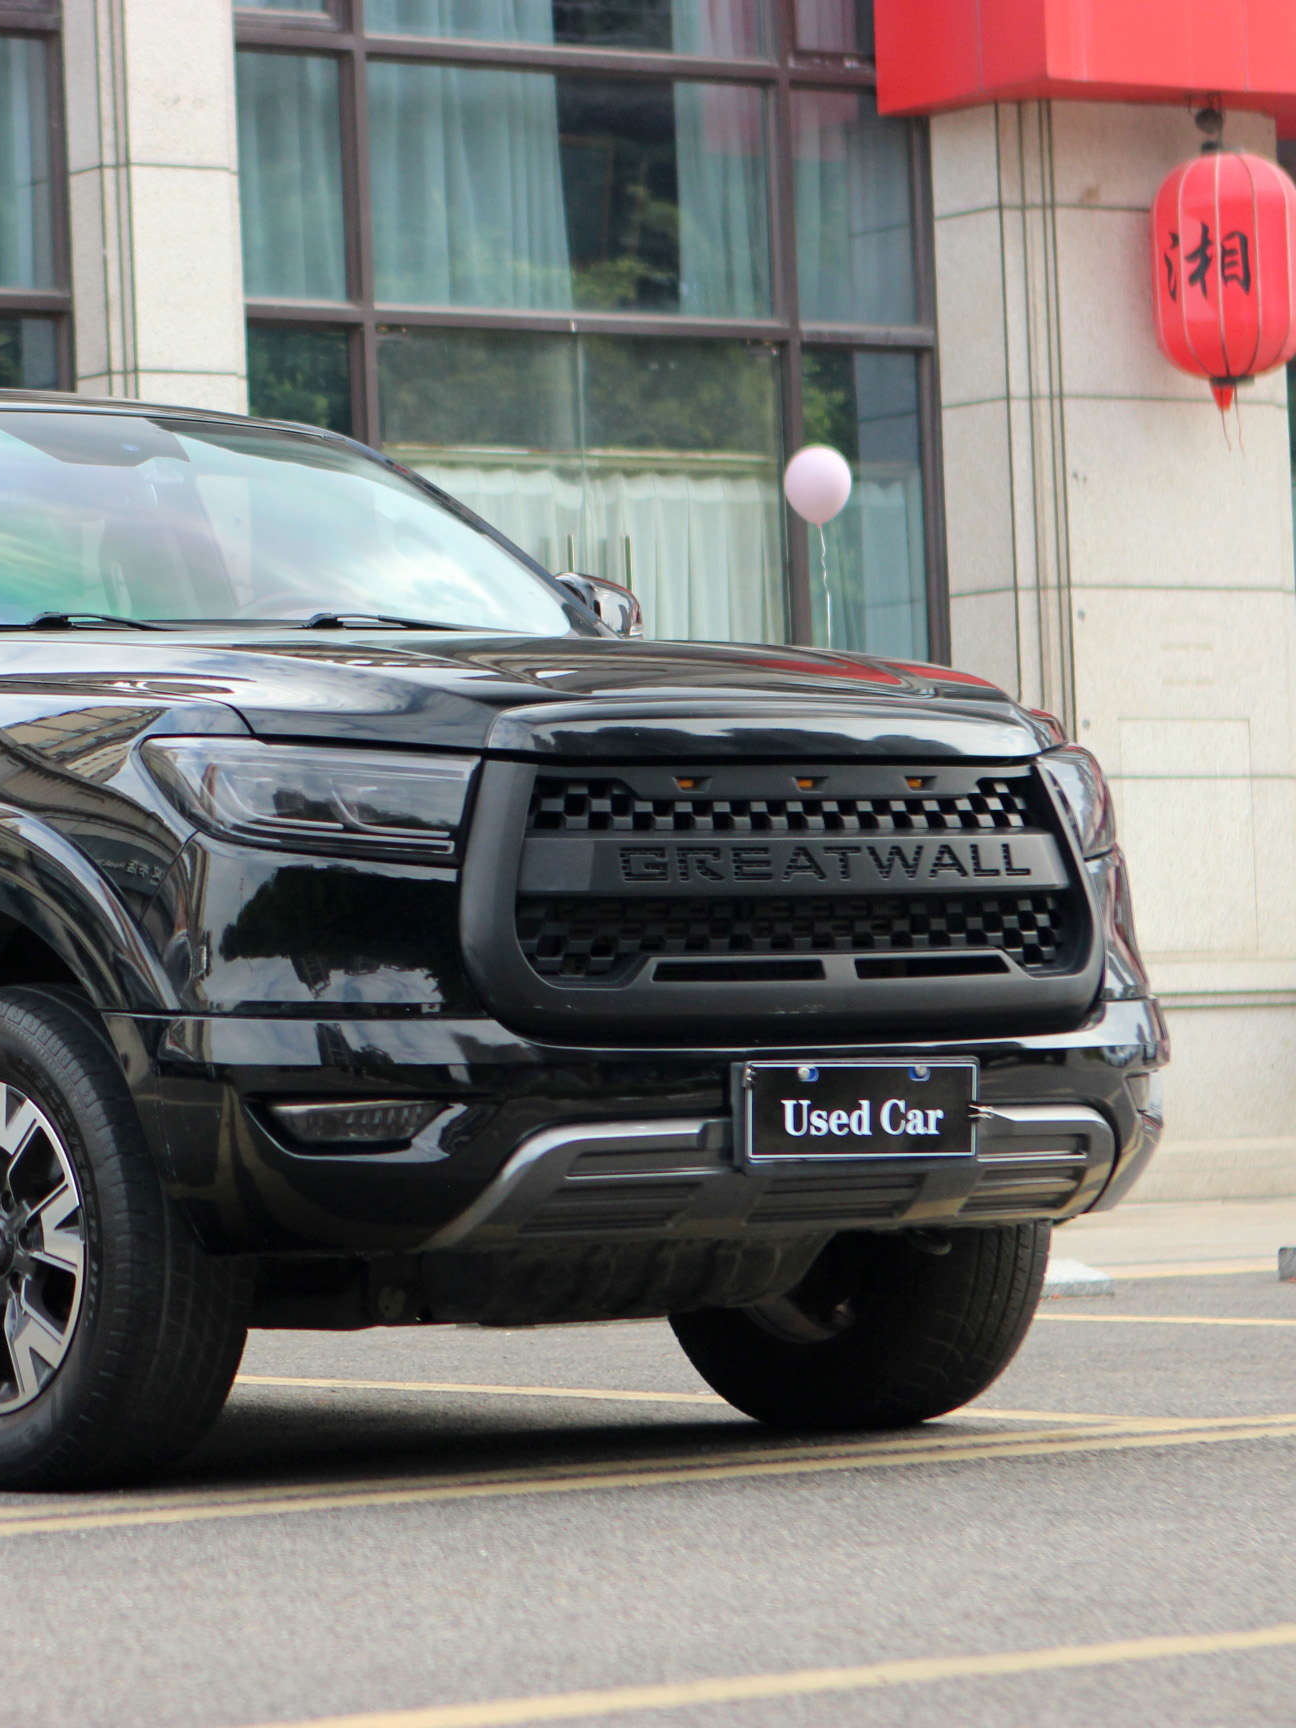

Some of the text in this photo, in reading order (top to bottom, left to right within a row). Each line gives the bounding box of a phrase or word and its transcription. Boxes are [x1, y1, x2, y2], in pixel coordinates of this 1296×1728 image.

[1164, 221, 1251, 303] 湘
[618, 843, 1031, 882] GREATWALL
[781, 1098, 944, 1136] Used Car
